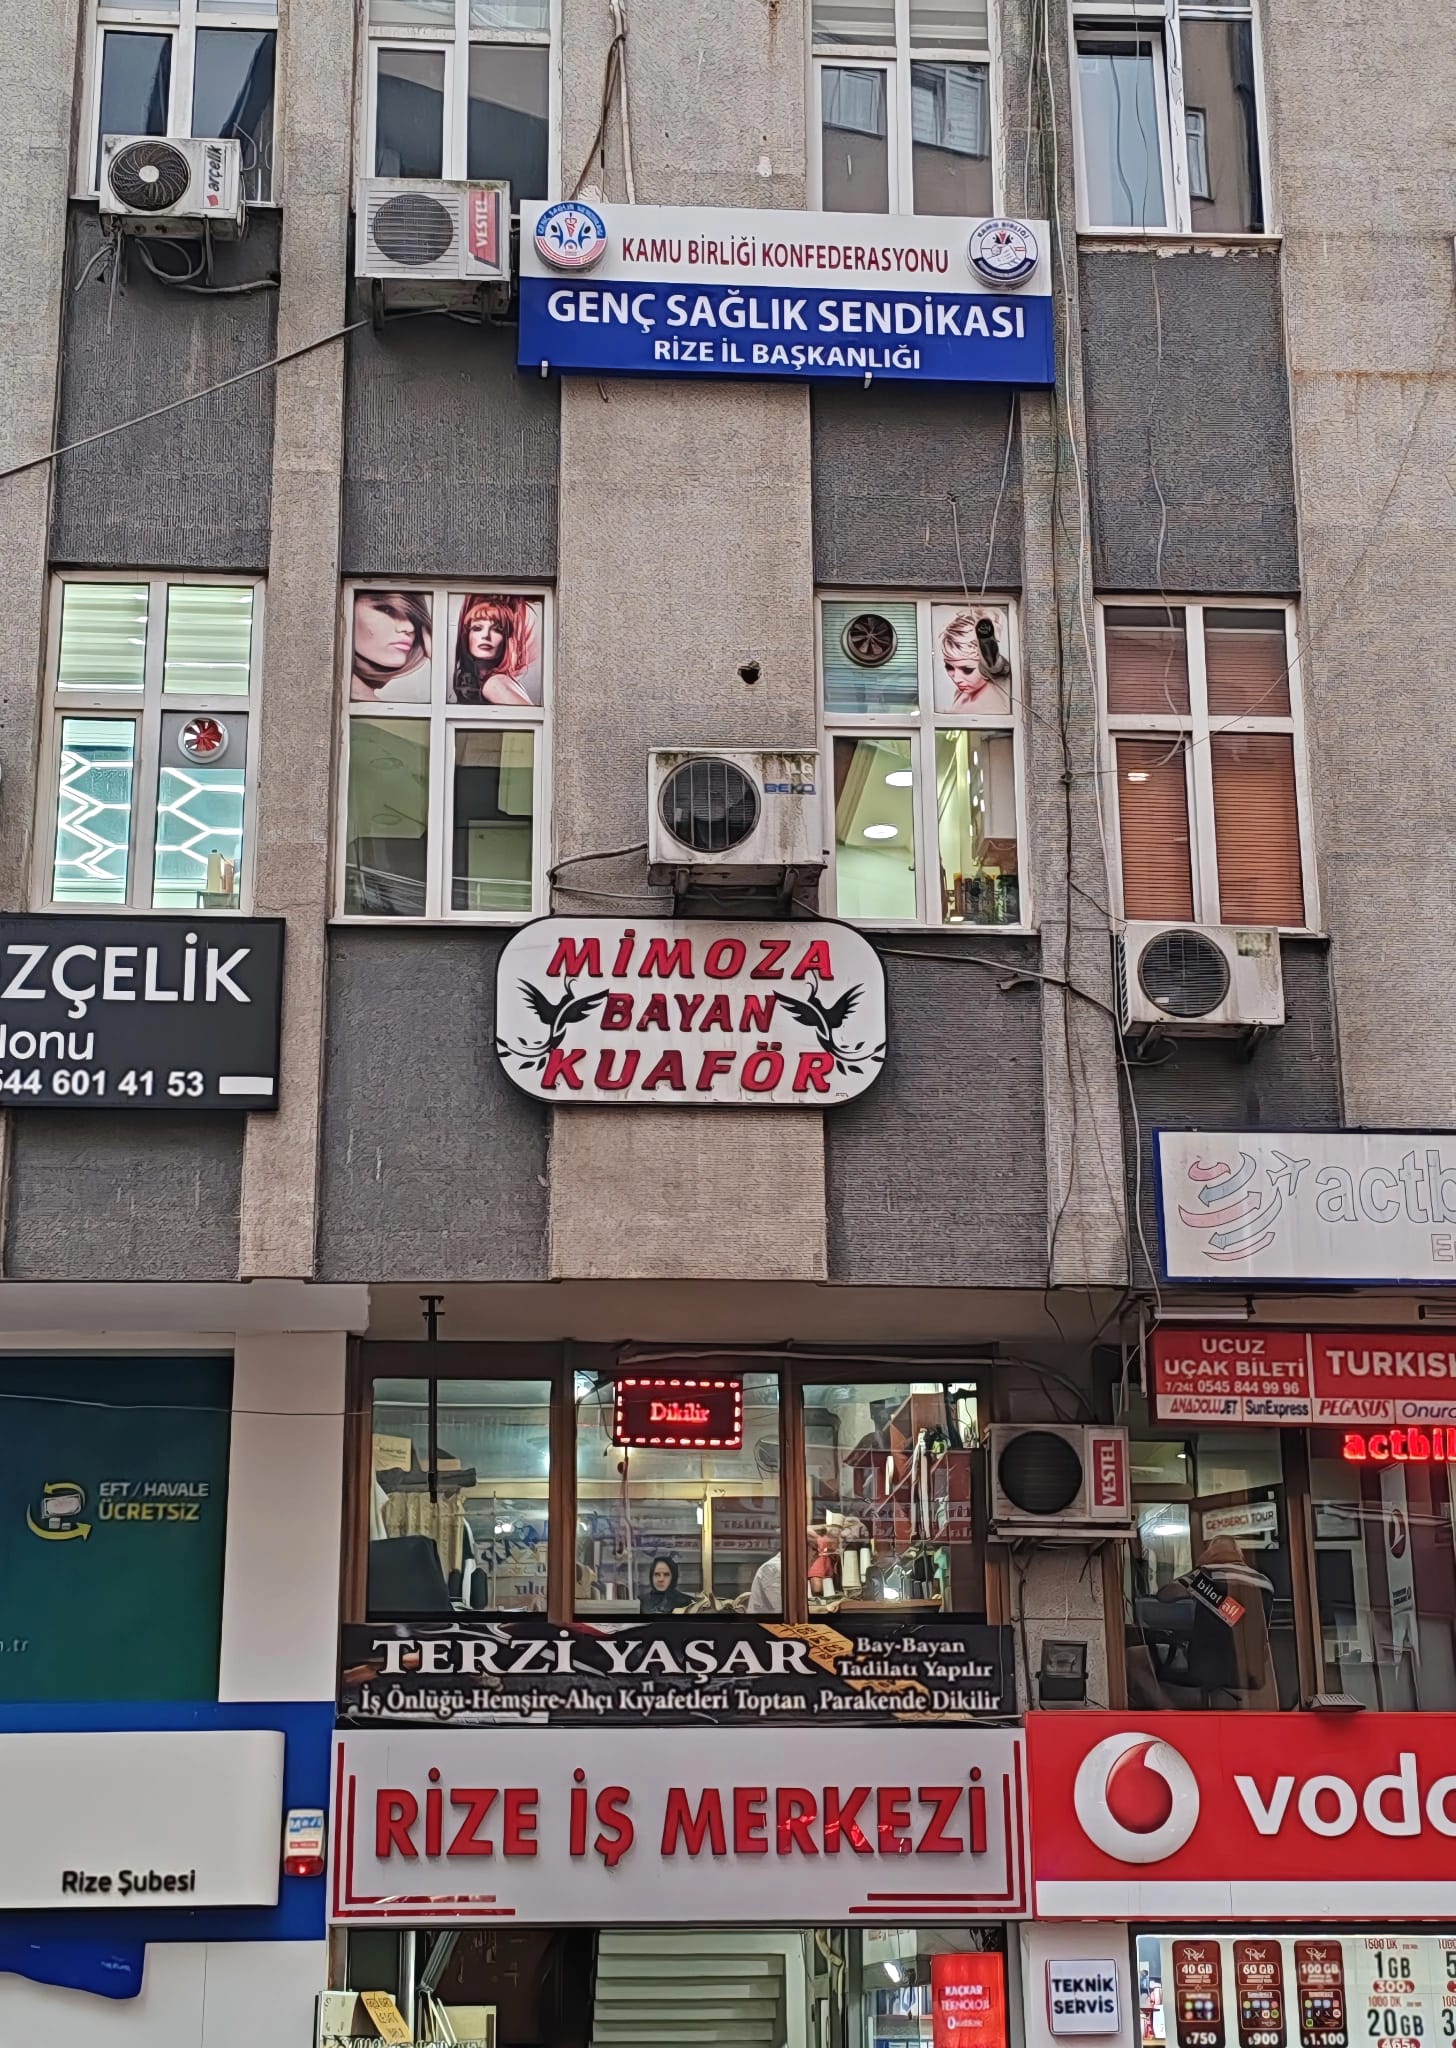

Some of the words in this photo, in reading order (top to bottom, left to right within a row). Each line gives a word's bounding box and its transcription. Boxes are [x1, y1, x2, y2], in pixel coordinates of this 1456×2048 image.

[206, 145, 223, 192] arçelik
[475, 191, 488, 248] VESTEL
[621, 237, 682, 263] KAMU
[688, 234, 757, 266] BİRLİĞİ
[762, 242, 949, 274] KONFEDERASYONU
[547, 289, 656, 333] GENÇ
[666, 288, 808, 331] SAĞLIK
[818, 296, 1026, 339] SENDİKASI
[654, 335, 714, 362] RİZE
[722, 337, 745, 363] İL
[752, 342, 921, 371] BAŞKANLIĞI
[546, 928, 835, 981] MİMOZA
[0, 932, 252, 1019] ZÇELİK
[600, 992, 777, 1033] BAYAN
[0, 1023, 95, 1060] lonu
[540, 1041, 836, 1093] KUAFÖR
[52, 1069, 107, 1096] 601
[117, 1070, 154, 1096] 41
[167, 1071, 205, 1097] 53
[1201, 1337, 1265, 1354] UCUZ
[1164, 1358, 1230, 1379] UÇAK
[1235, 1357, 1305, 1378] BİLETİ
[1197, 1380, 1231, 1394] 0545
[1234, 1380, 1259, 1394] 844
[1262, 1381, 1279, 1394] 99
[649, 1402, 711, 1423] Dikilir
[1245, 1398, 1309, 1418] SunExpress
[1319, 1400, 1391, 1418] PEGASUS
[1100, 1441, 1117, 1505] VESTEL
[99, 1482, 131, 1497] EFT
[144, 1482, 209, 1497] HAVALE
[372, 1629, 578, 1675] TERZİ
[596, 1639, 817, 1684] YAŞAR
[856, 1636, 966, 1657] Bay-Bayan
[837, 1659, 918, 1678] Tadilatı
[923, 1660, 994, 1681] Yapılır
[361, 1685, 382, 1714] İş
[387, 1684, 614, 1718] Önlüğü-Hemşire-Ahçı
[618, 1688, 729, 1718] Kıyafetleri
[734, 1689, 807, 1717] Toptan
[932, 1689, 1002, 1712] Dikilir
[375, 1767, 539, 1858] RİZE
[570, 1767, 635, 1867] İŞ
[660, 1766, 988, 1856] MERKEZİ
[61, 1870, 112, 1893] Rize
[117, 1869, 197, 1897] Şubesi
[1181, 1964, 1196, 1975] 40
[1197, 1964, 1213, 1975] GB
[1243, 1964, 1258, 1975] 60
[1259, 1964, 1275, 1975] GB
[1301, 1963, 1322, 1975] 100
[1323, 1963, 1340, 1975] GB
[1052, 1973, 1115, 1994] TEKNİK
[1054, 1995, 1115, 2015] SERVİS
